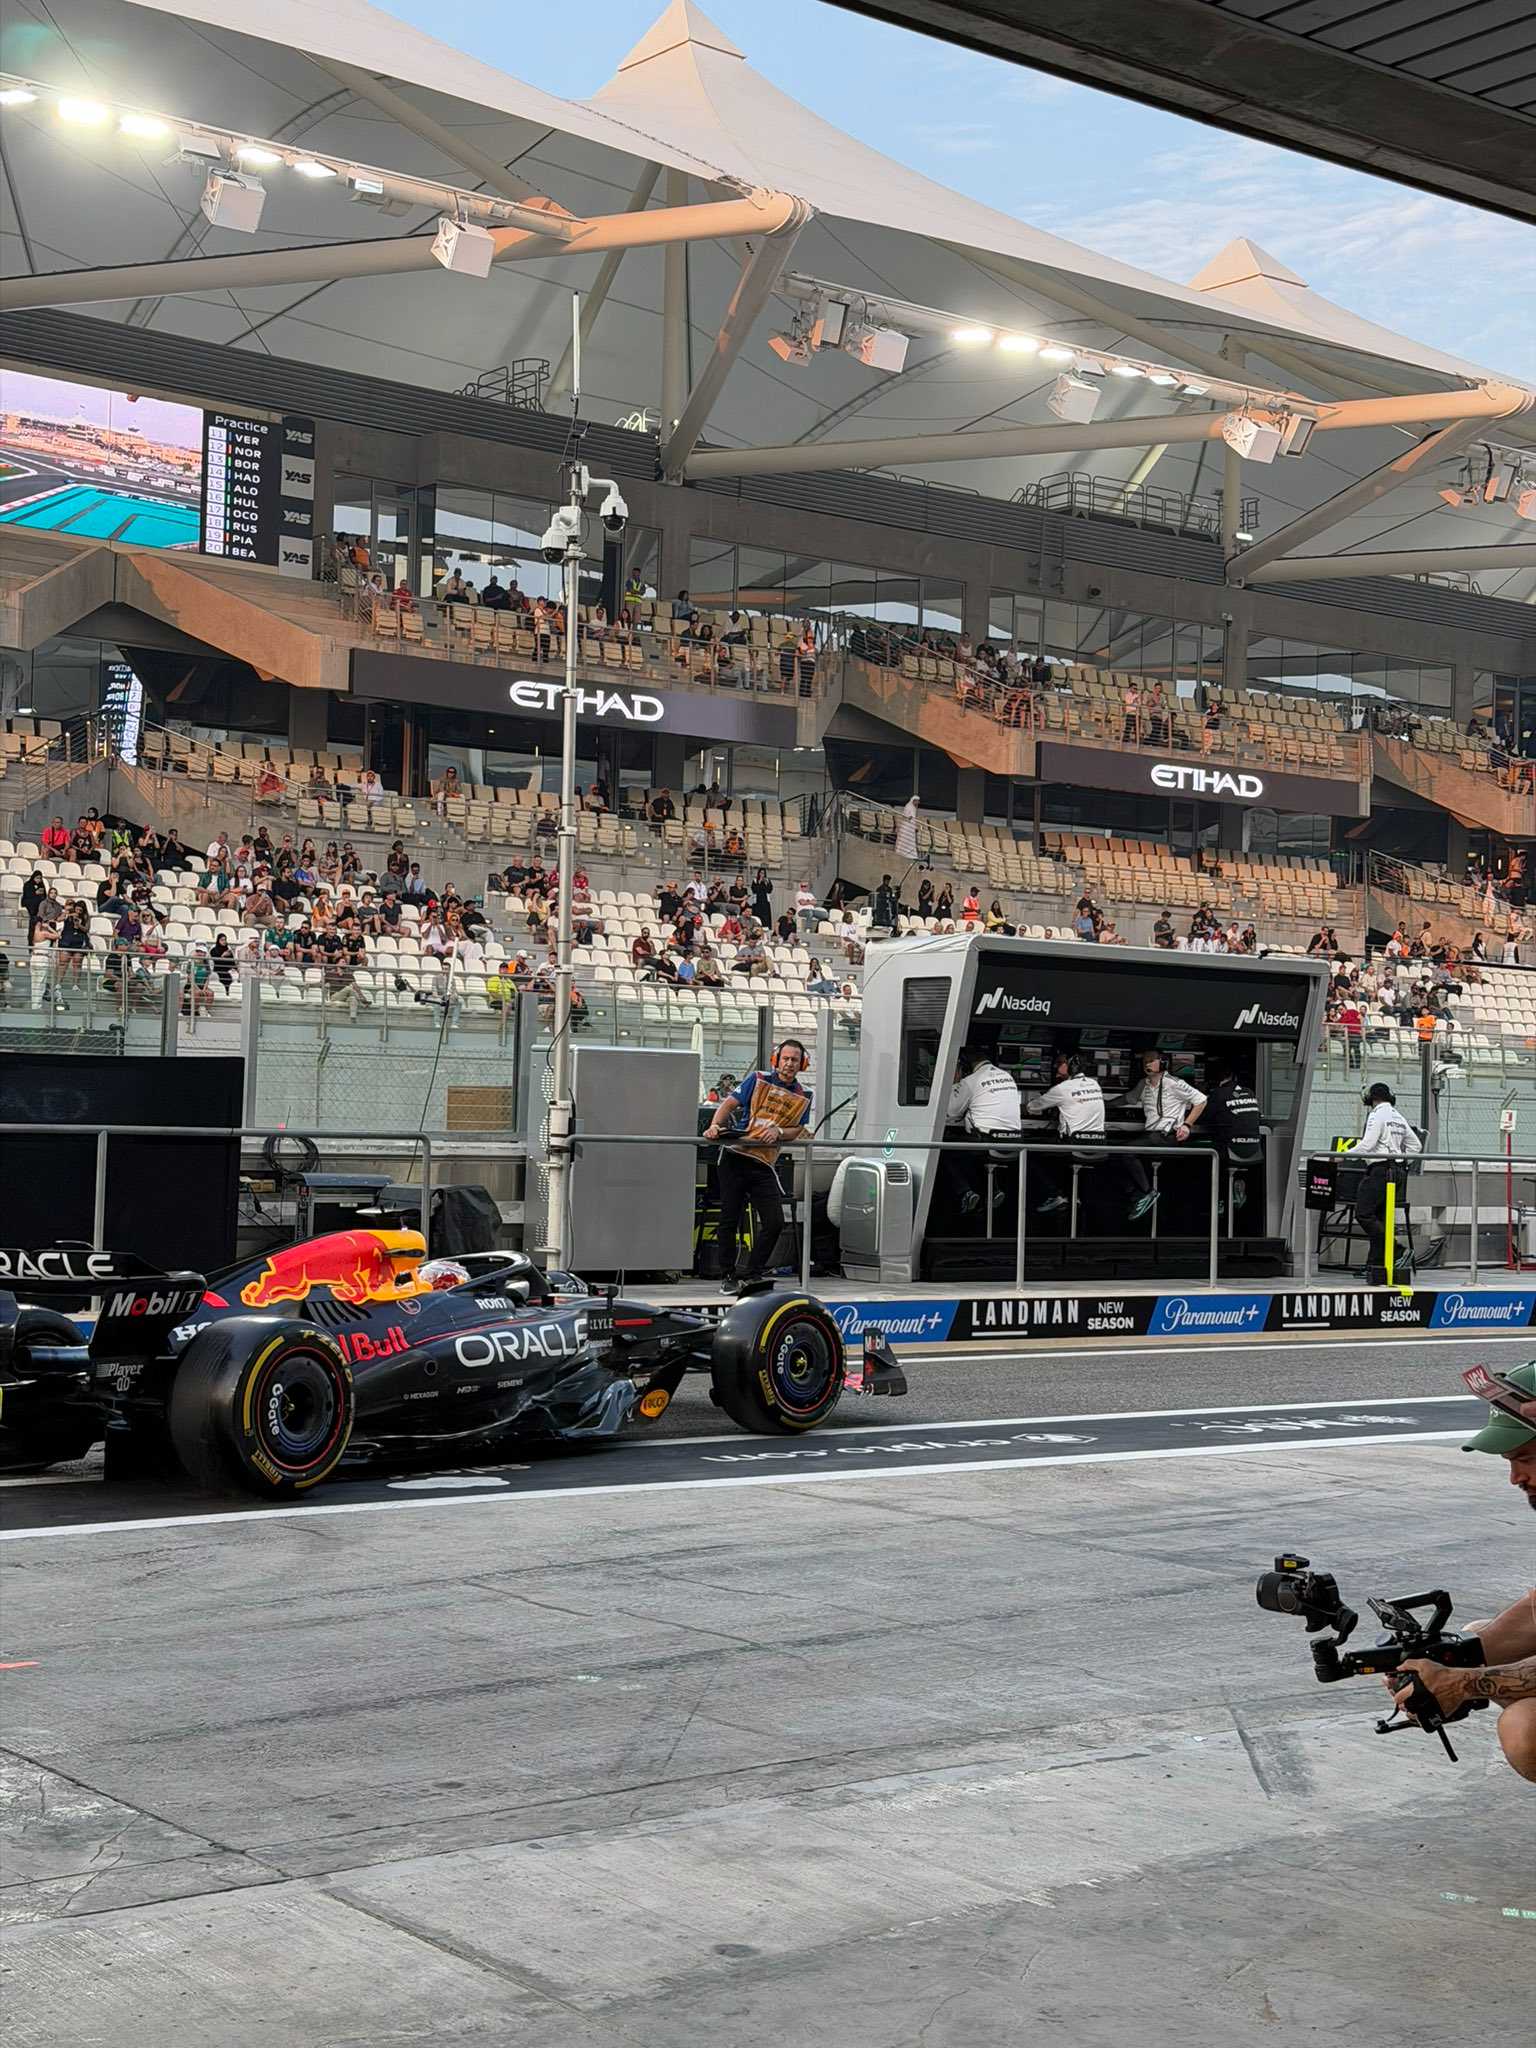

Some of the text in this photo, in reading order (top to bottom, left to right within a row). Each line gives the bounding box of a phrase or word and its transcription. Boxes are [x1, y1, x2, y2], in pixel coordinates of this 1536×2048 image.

[215, 416, 269, 434] Practice
[210, 428, 260, 446] 11 VER
[286, 429, 313, 444] YAS
[209, 441, 262, 459] 12 NOR
[209, 454, 260, 471] 13 BOR
[209, 467, 261, 483] 14 HAD
[284, 469, 312, 484] YAS
[209, 480, 258, 496] 15 ALO
[208, 492, 259, 509] 16 HUL
[208, 505, 258, 521] 17 OCO
[283, 510, 311, 525] YAS
[208, 517, 258, 534] 18 RUS
[207, 529, 254, 546] 19 PIA
[206, 542, 257, 559] 20 BEA
[282, 551, 310, 565] YAS
[509, 681, 665, 722] ETHAD
[1151, 764, 1264, 798] ETIHAD
[1001, 995, 1051, 1016] Nasdaq
[1257, 1011, 1299, 1031] Nasdaq
[981, 1078, 1015, 1087] PETRONA
[1072, 1088, 1102, 1098] PETRONA
[1226, 1098, 1259, 1107] PETRONA
[108, 1291, 180, 1317] Mobil
[1098, 1302, 1124, 1314] NEW
[1282, 1294, 1373, 1319] LANDMAN
[1389, 1296, 1412, 1308] NEW
[1441, 1294, 1525, 1325] Paramount+
[833, 1304, 942, 1335] Paramount+
[971, 1300, 1079, 1326] LANDMAN
[1161, 1297, 1259, 1331] Paramount+
[1380, 1310, 1420, 1322] SEASON
[1087, 1316, 1134, 1330] SEASON
[352, 1326, 411, 1362] Bull
[455, 1318, 588, 1368] ORACLE
[107, 1362, 144, 1378] Player
[702, 1438, 1011, 1462] crypto.com
